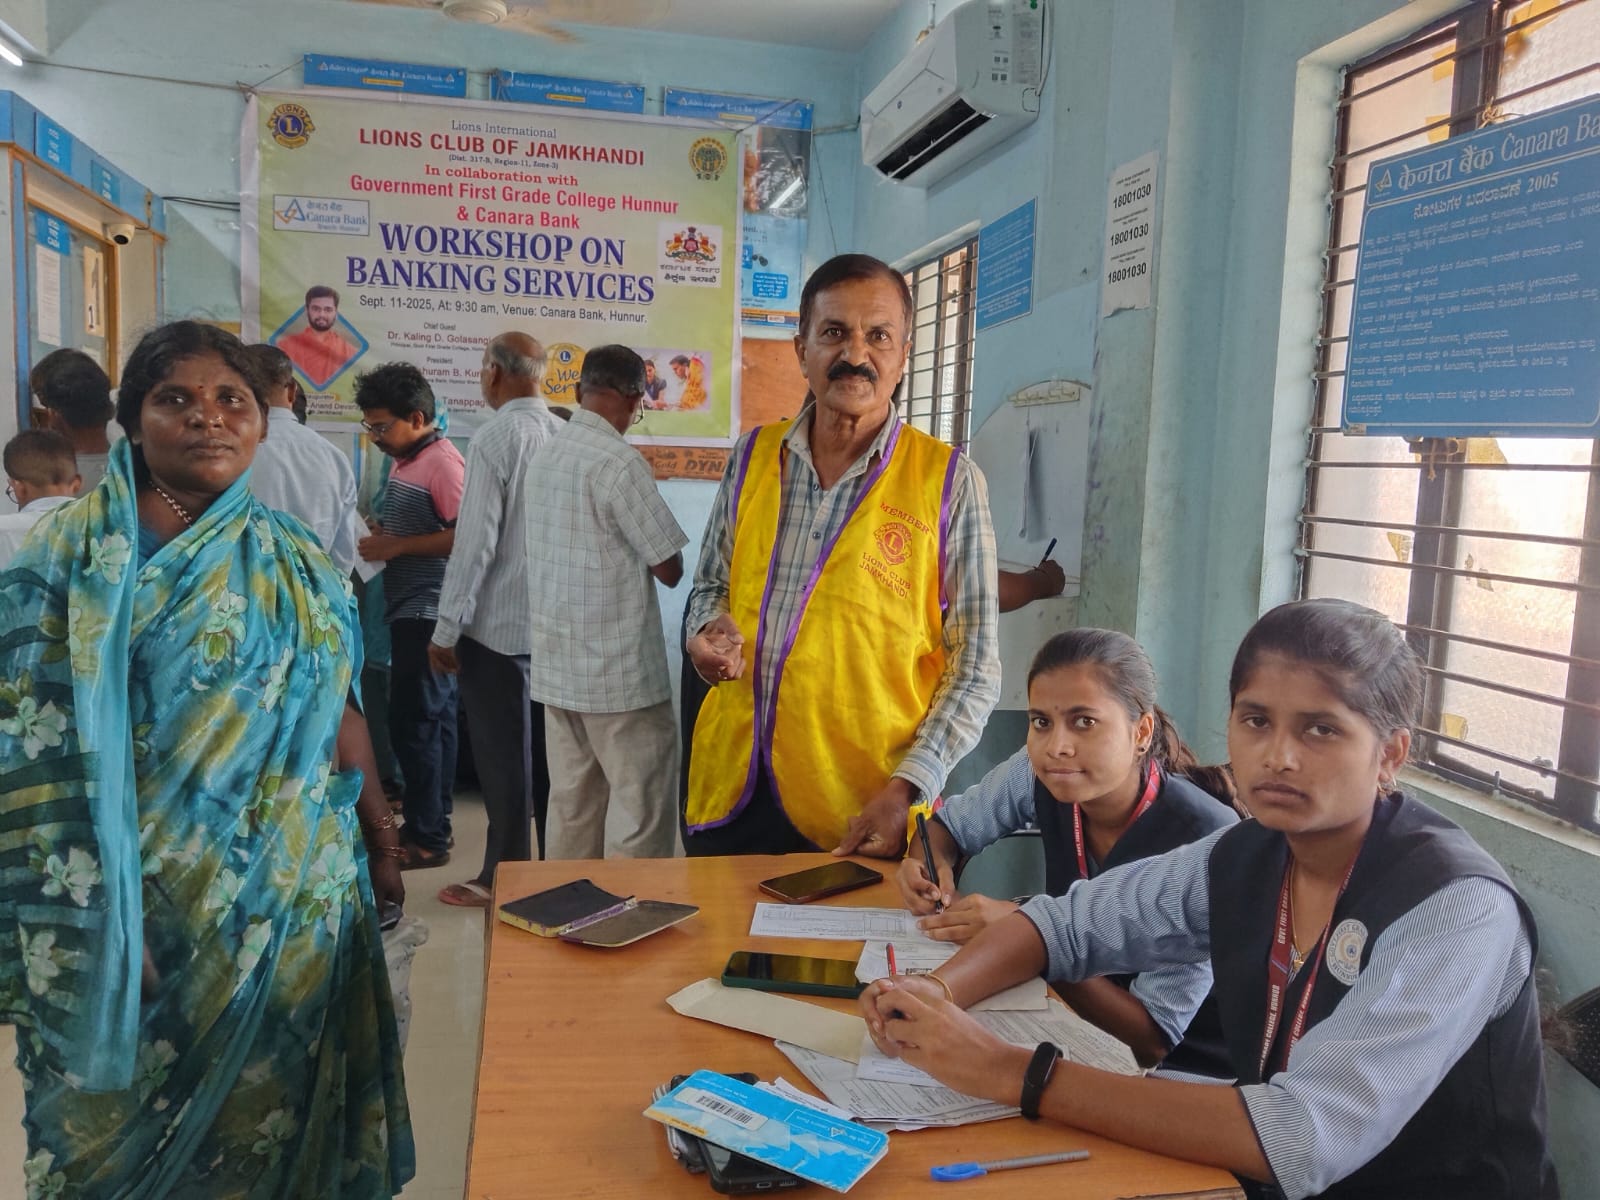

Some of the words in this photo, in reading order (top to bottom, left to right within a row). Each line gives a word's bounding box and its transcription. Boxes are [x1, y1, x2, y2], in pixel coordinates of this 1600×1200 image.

[451, 119, 482, 133] Lions
[485, 122, 557, 139] International
[1501, 124, 1569, 162] Canara
[1575, 112, 1600, 142] Ba
[359, 128, 422, 148] LIONS
[430, 133, 485, 153] CLUB
[492, 138, 519, 156] OF
[525, 141, 645, 166] JAMKHANDI
[425, 164, 440, 176] In
[445, 167, 542, 184] collaboration
[547, 174, 578, 187] with
[1397, 156, 1455, 191] केनरा
[1459, 144, 1495, 175] बैंक
[1527, 171, 1560, 194] 2005
[350, 174, 453, 198] Government
[459, 182, 497, 201] First
[502, 185, 551, 205] Grade
[556, 190, 616, 212] College
[622, 194, 679, 215] Hunnur
[1113, 184, 1151, 209] 18001030
[306, 211, 341, 224] Canara
[343, 214, 368, 226] Bank
[457, 204, 469, 221] &
[475, 206, 534, 227] Canara
[540, 211, 580, 230] Bank
[379, 222, 573, 264] WORKSHOP
[580, 236, 625, 267] ON
[1110, 223, 1149, 247] 18001030
[346, 256, 497, 295] BANKING
[503, 266, 655, 305] SERVICES
[1108, 262, 1147, 285] 18001030
[359, 294, 386, 309] Sept.
[390, 297, 435, 312] 11-2025,
[438, 300, 452, 311] At:
[455, 301, 478, 313] 9:30
[480, 304, 499, 315] am,
[502, 303, 537, 317] Venue:
[540, 305, 576, 319] Canara
[579, 307, 607, 322] Bank,
[609, 309, 647, 323] Hunnur.
[387, 331, 401, 340] Dr.
[403, 331, 432, 343] Kaling
[434, 333, 442, 342] D.
[423, 322, 439, 331] Chief
[440, 322, 456, 331] Guest
[426, 356, 453, 364] President
[422, 367, 450, 377] huram
[453, 368, 462, 377] B.
[465, 369, 481, 378] Kur
[556, 368, 580, 382] We
[543, 378, 576, 396] Ser
[442, 396, 486, 408] Tanappag
[880, 501, 930, 535] MEMBER
[859, 561, 908, 599] JAMKHANDI
[862, 552, 888, 573] LIONS
[889, 570, 912, 590] CLUB
[1331, 962, 1359, 981] HUNNU
